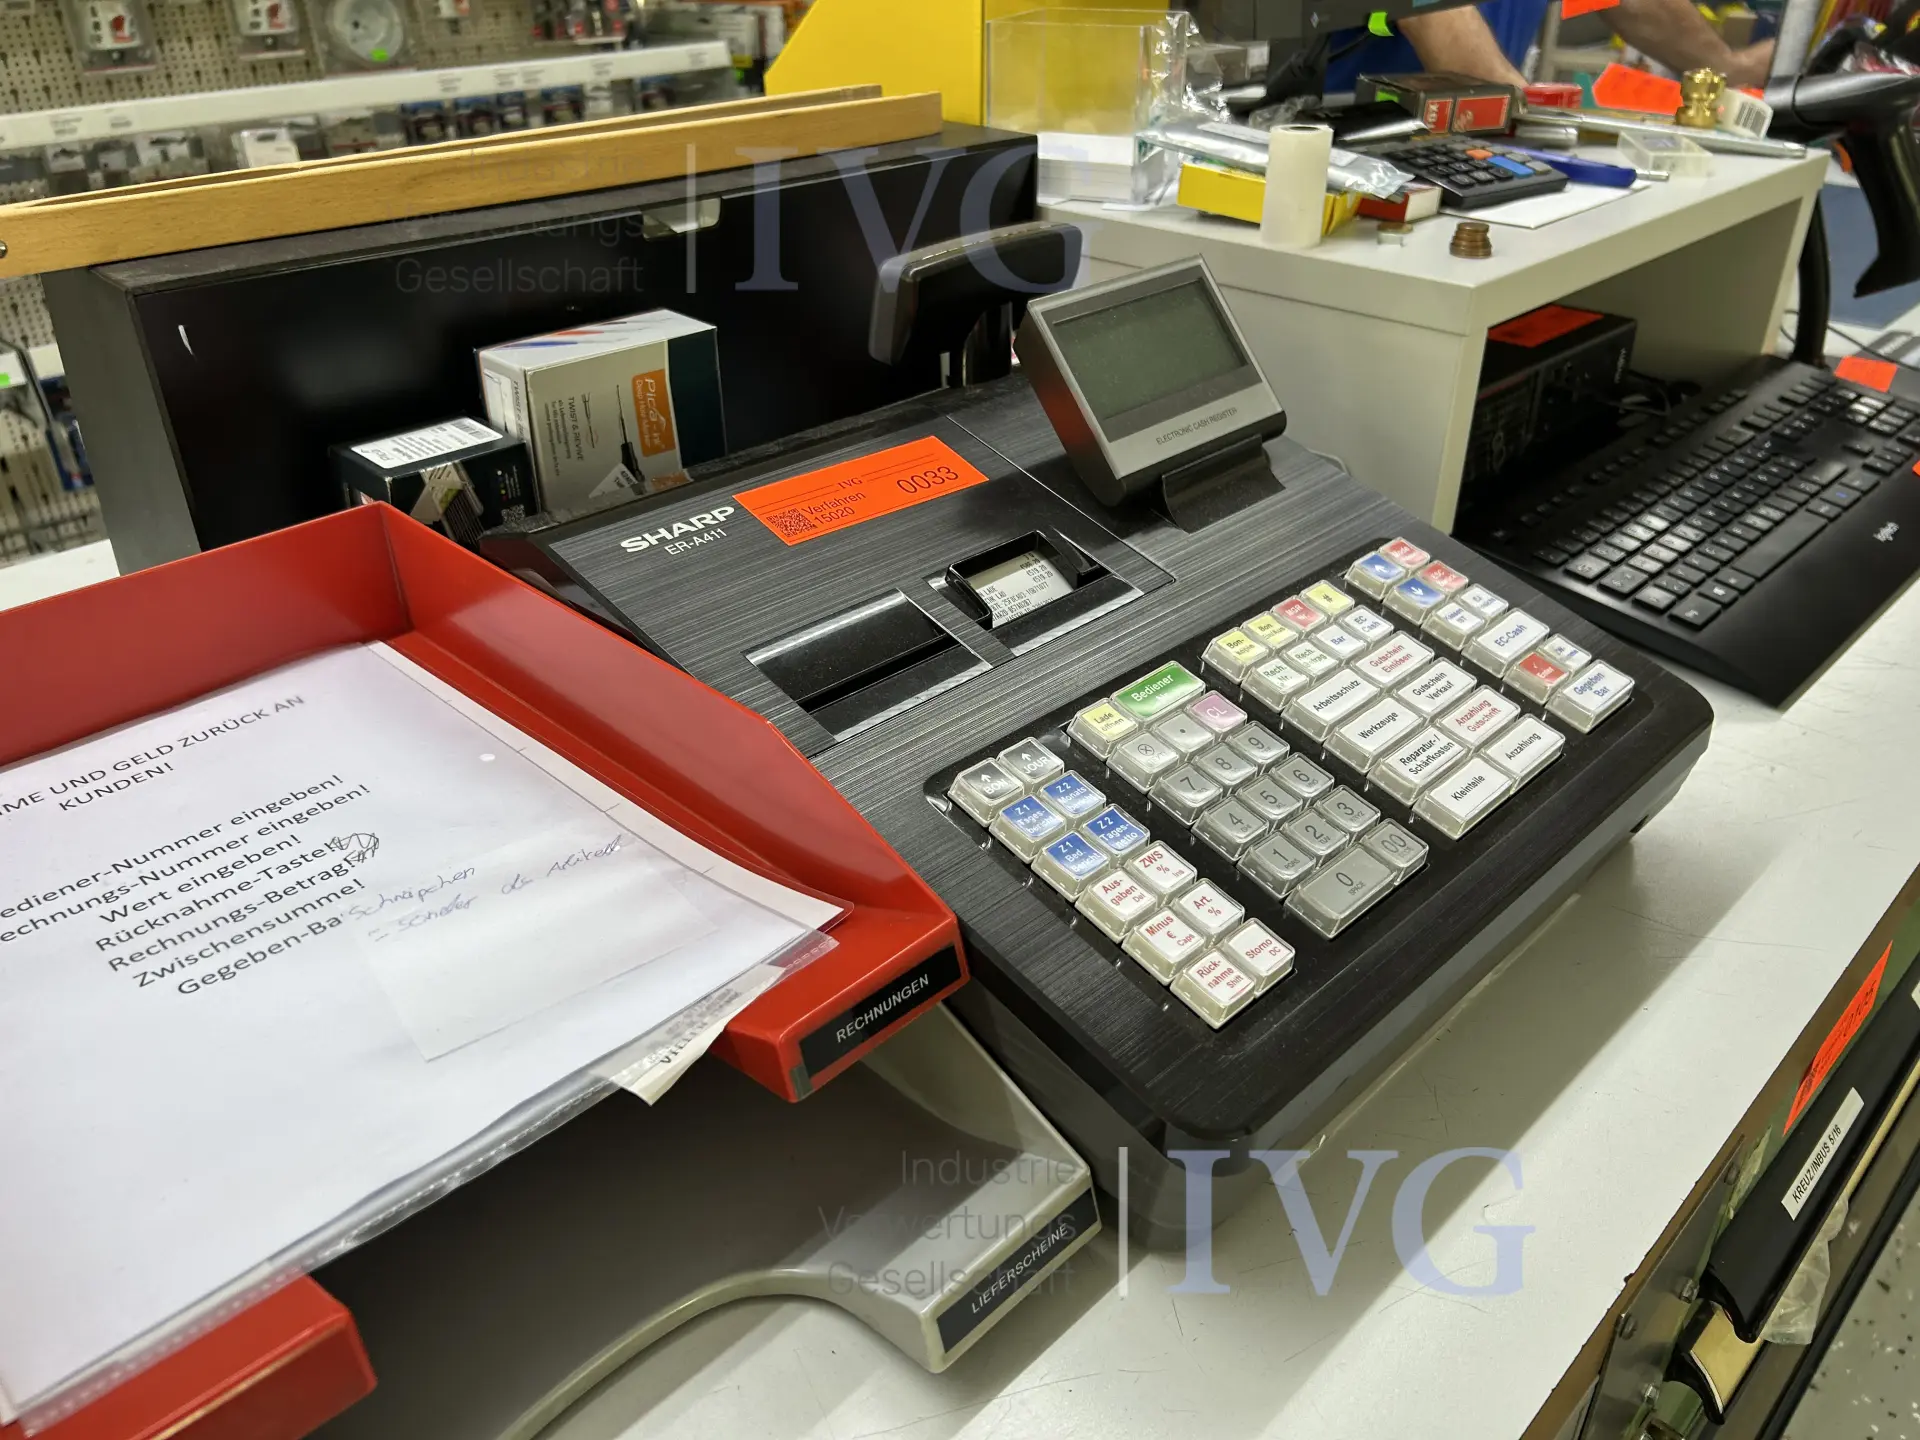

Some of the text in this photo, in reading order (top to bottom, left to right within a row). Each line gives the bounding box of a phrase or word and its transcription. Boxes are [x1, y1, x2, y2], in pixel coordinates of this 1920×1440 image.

[1156, 407, 1238, 445] ELECTRONIC CASH REGISTER
[837, 476, 863, 490] IVG
[896, 466, 959, 495] 0033
[802, 491, 866, 515] Verfahren
[813, 506, 856, 526] 15020
[620, 506, 735, 553] SHARP
[664, 528, 728, 555] ER-A411
[1330, 635, 1345, 645] Bar
[1494, 623, 1527, 647] EC-Cash
[1302, 654, 1328, 668] Btrag
[1369, 643, 1405, 668] Gutschein
[1382, 652, 1412, 674] Einlösen
[1130, 673, 1174, 702] Bediener
[1412, 671, 1447, 696] Gutschein
[1426, 681, 1454, 701] Verkauf
[1573, 672, 1605, 696] Gegeben
[1593, 685, 1611, 697] Bar
[1313, 679, 1361, 712] Arbeitsschutz
[1094, 712, 1114, 724] Lade
[1206, 704, 1228, 719] CL
[1455, 699, 1491, 727] Anzahlung
[1466, 707, 1502, 732] Gutschrift
[1357, 710, 1399, 740] Werkzeuge
[50, 769, 107, 795] UND
[113, 744, 174, 772] GELD
[178, 708, 270, 748] ZURÜCK
[275, 695, 306, 714] AN
[1248, 736, 1265, 750] 9
[1505, 732, 1541, 761] Anzahlung
[1024, 756, 1051, 774] JOUR
[1215, 757, 1232, 771] 8
[1408, 741, 1455, 775] Schärfkosten
[59, 762, 174, 812] KUNDEN!
[984, 779, 1010, 795] BON
[1180, 776, 1197, 791] 7
[1292, 769, 1310, 783] 6
[1259, 790, 1278, 805] 5
[1451, 774, 1485, 801] Kleinteile
[230, 775, 345, 826] eingeben!
[257, 784, 371, 837] eingeben!
[1337, 802, 1355, 816] 3
[1229, 812, 1244, 826] 4
[1101, 822, 1129, 842] Tages-
[1115, 831, 1139, 849] netto
[1305, 825, 1323, 840] 2
[1381, 832, 1407, 854] 00
[1139, 850, 1164, 869] ZWS
[1272, 848, 1289, 862] 1
[99, 834, 302, 924] Wert eingeben!
[1156, 865, 1170, 874] %
[1335, 871, 1354, 887] 0
[95, 842, 335, 951] Rücknahme-Taste!
[1102, 878, 1124, 894] Aus-
[1110, 884, 1137, 906] gaben
[1194, 894, 1213, 910] Art.
[1208, 907, 1222, 916] %
[108, 857, 356, 972] Rechnungs-Betrag!
[132, 878, 366, 988] Zwischensumme!
[1145, 915, 1174, 937] Minus
[1166, 930, 1177, 940] €
[177, 912, 343, 996] Gegeben-Ba
[1245, 938, 1273, 959] Storno
[1269, 946, 1281, 957] DC
[1197, 959, 1221, 979] Rück-
[1207, 967, 1234, 989] nahme
[1227, 975, 1243, 989] Shift
[835, 974, 930, 1043] RECHNUNGEN
[1792, 1124, 1842, 1203] KREUZ/INBUS 5/16
[971, 1222, 1068, 1315] LIEFERSCHEINE
